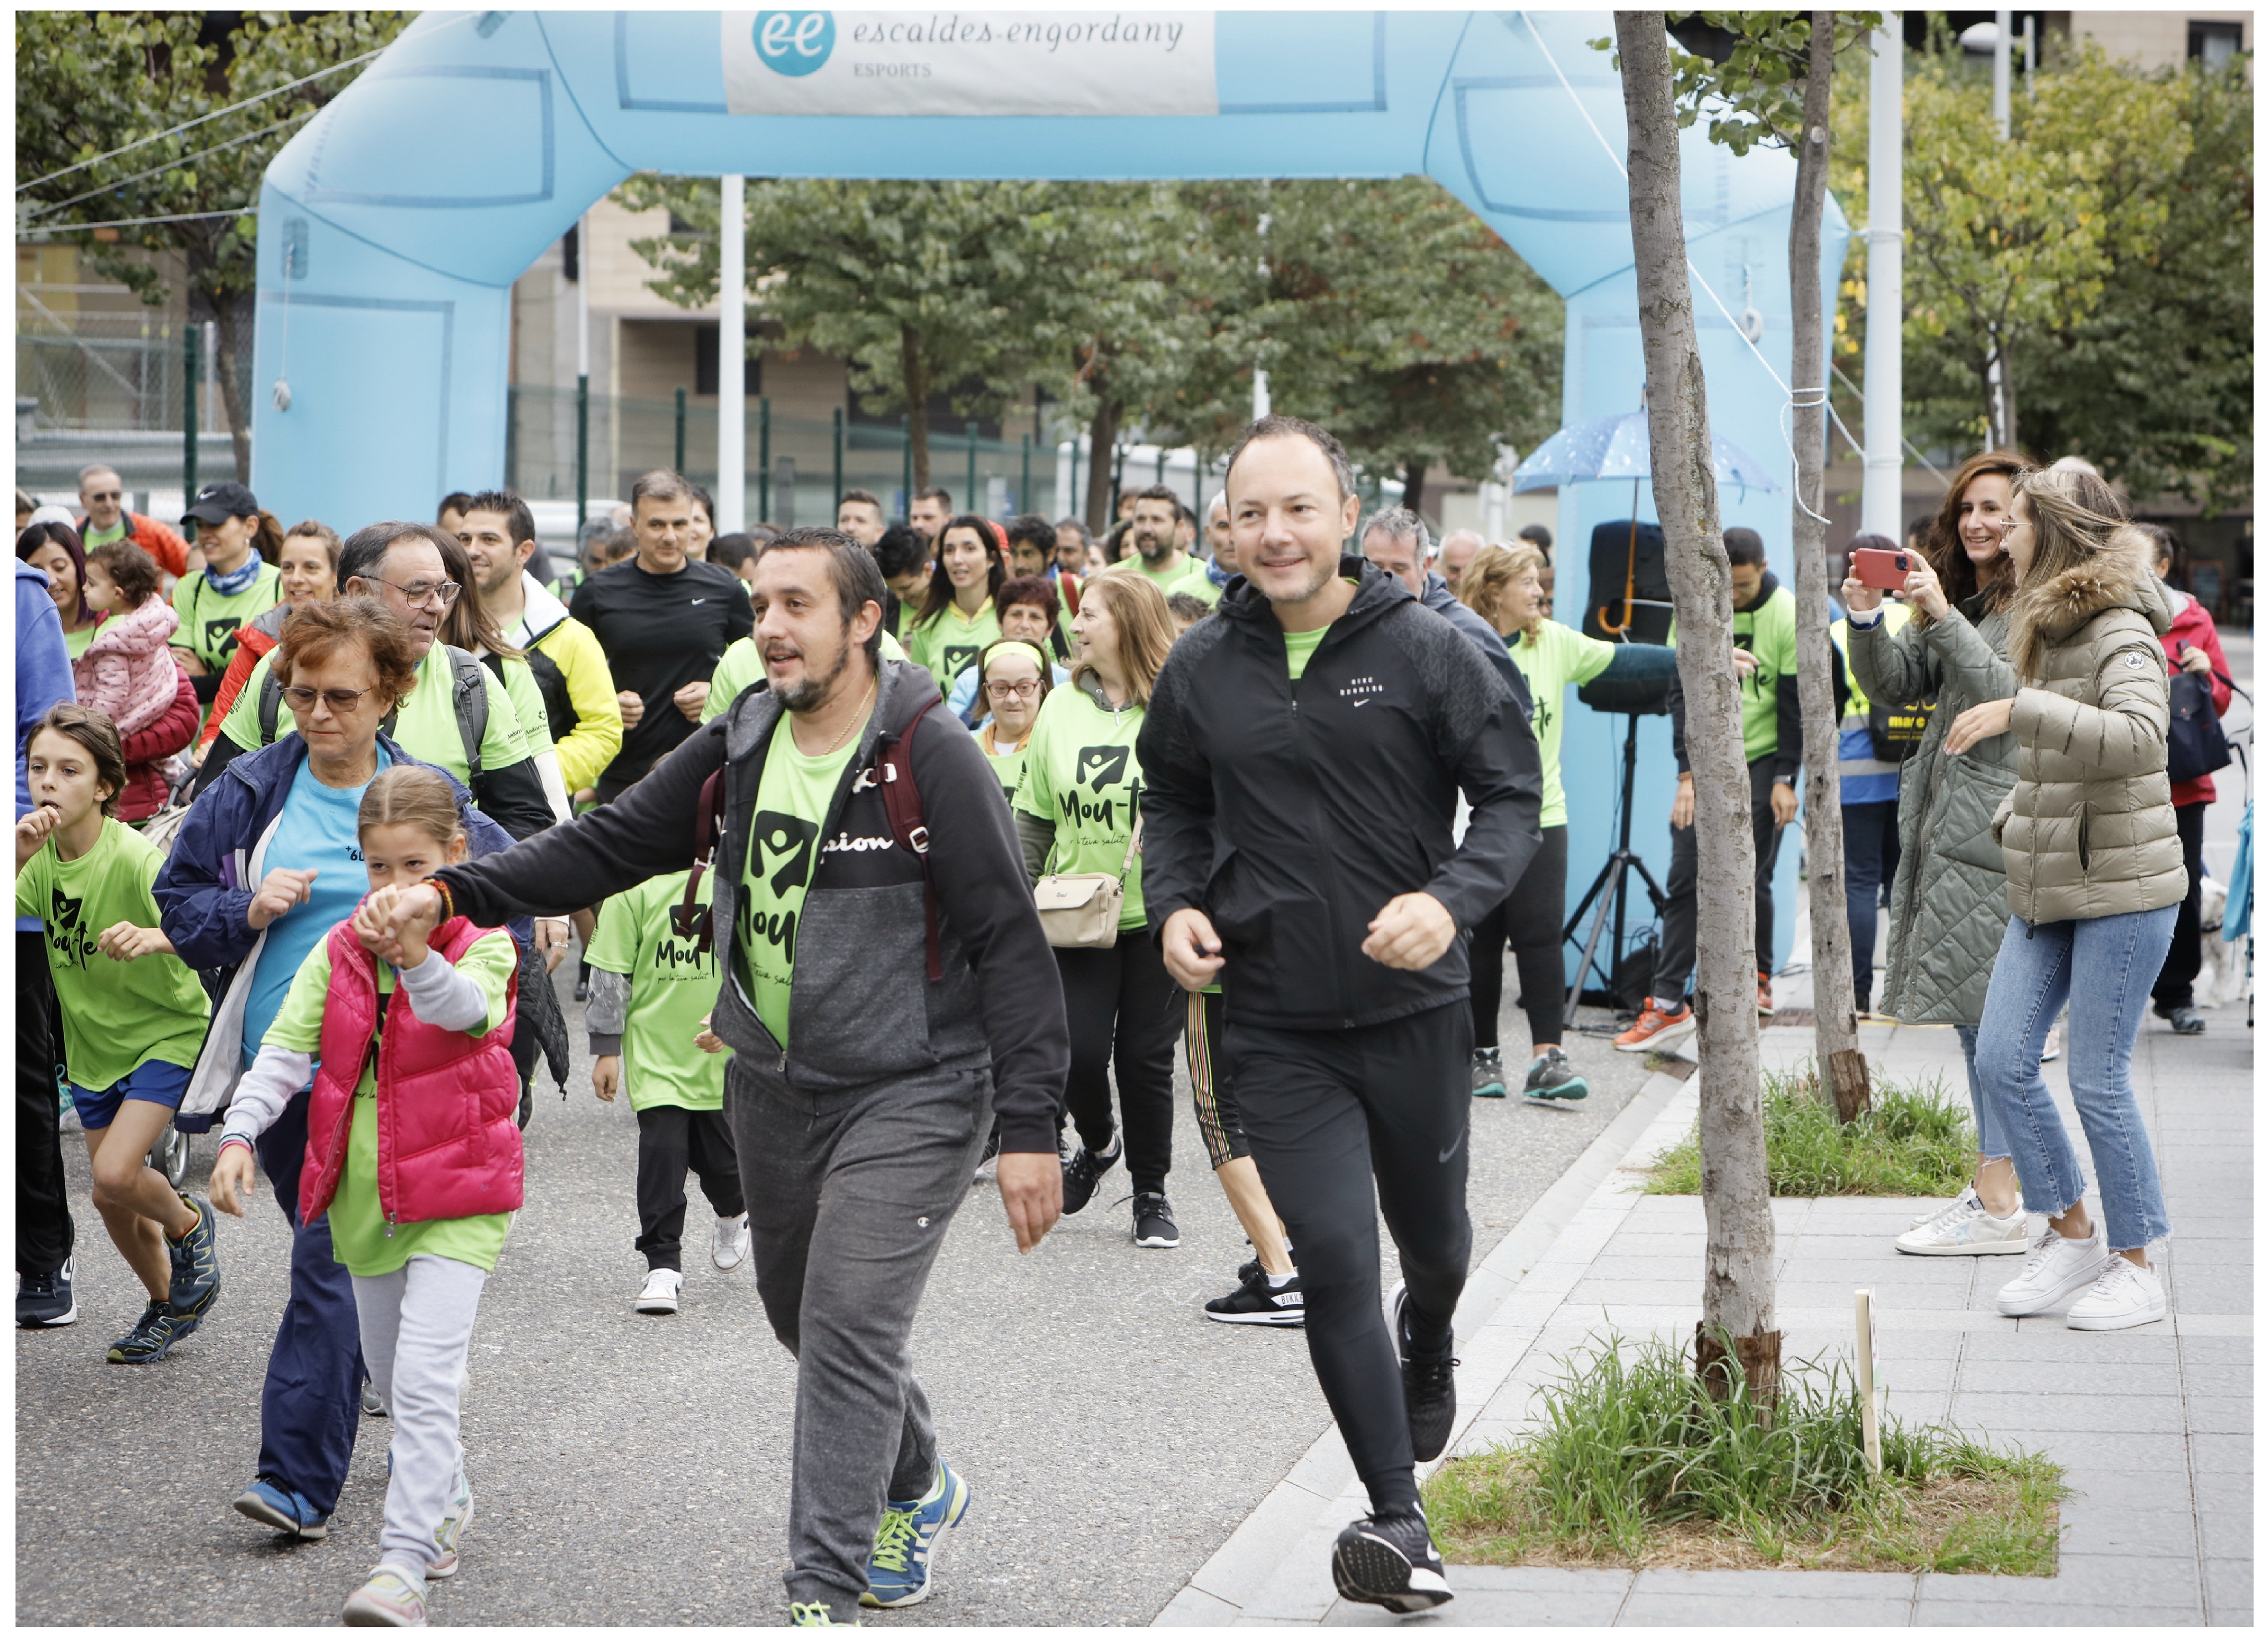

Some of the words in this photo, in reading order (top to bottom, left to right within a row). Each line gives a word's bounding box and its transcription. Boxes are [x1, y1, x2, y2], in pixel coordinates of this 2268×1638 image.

[853, 13, 1184, 53] escaldes-engordany
[854, 62, 932, 78] ESPORTS
[1059, 777, 1145, 833] Mou-t
[1102, 832, 1130, 846] salut
[690, 971, 710, 981] salut
